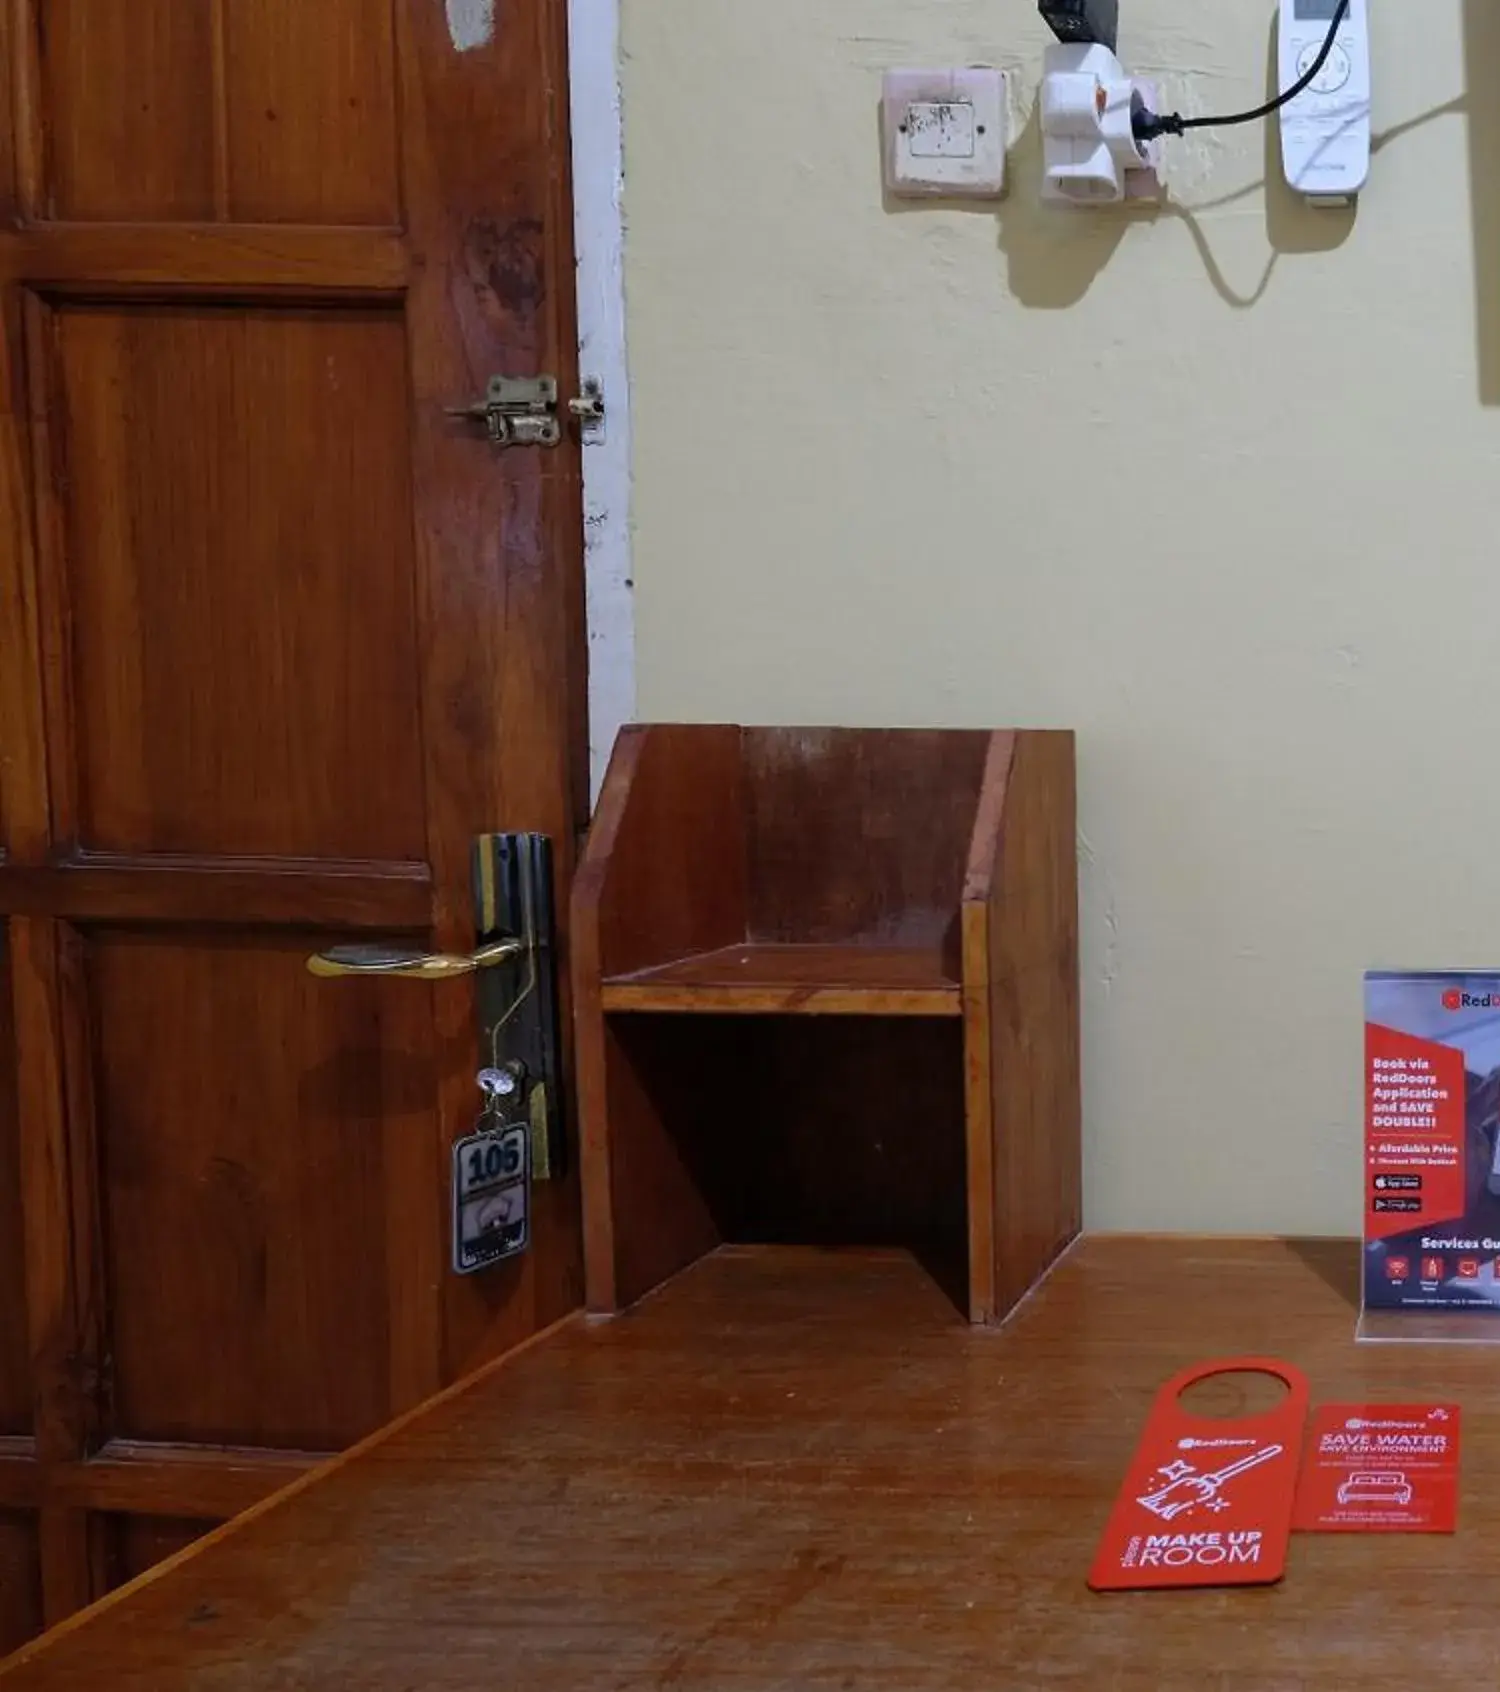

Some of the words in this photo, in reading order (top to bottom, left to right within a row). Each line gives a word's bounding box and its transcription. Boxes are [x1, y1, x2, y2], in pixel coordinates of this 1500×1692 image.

[1373, 1057, 1407, 1070] Book
[1409, 1058, 1429, 1070] via
[1373, 1087, 1449, 1101] Application
[1372, 1101, 1398, 1113] and
[1400, 1102, 1435, 1113] SAVE
[468, 1137, 520, 1187] 105
[1420, 1236, 1480, 1250] Services
[1321, 1433, 1370, 1446] SAVE
[1377, 1434, 1448, 1446] WATER
[1145, 1532, 1222, 1547] MAKE
[1227, 1531, 1263, 1545] UP
[1138, 1545, 1261, 1567] ROOM
